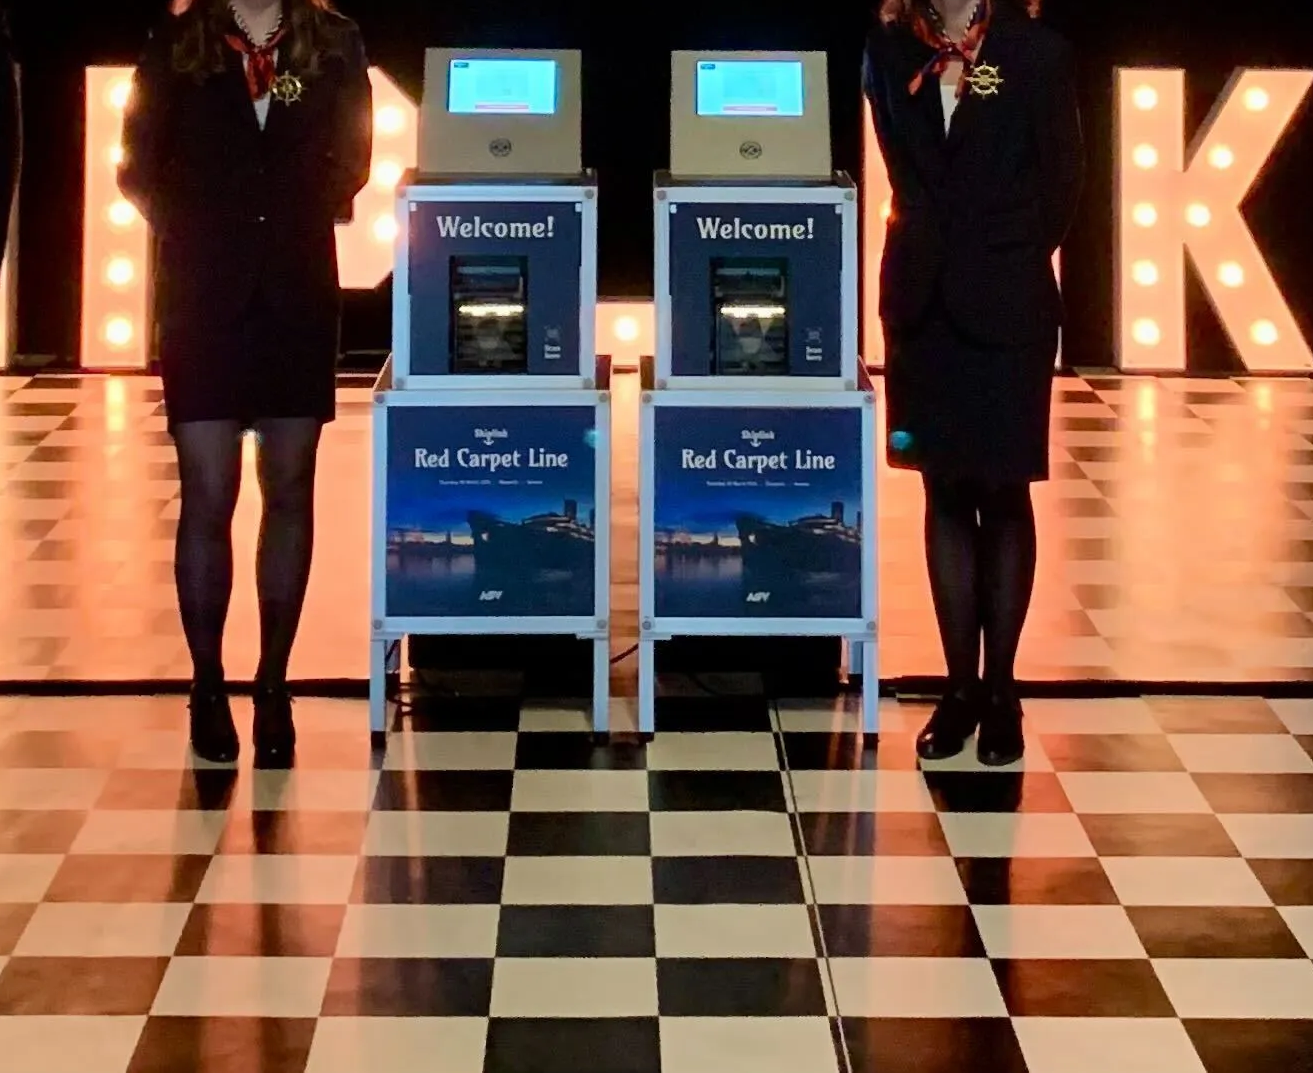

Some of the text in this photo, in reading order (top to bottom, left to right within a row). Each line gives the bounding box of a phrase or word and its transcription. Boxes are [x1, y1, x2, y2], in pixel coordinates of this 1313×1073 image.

[435, 215, 554, 238] Welcome!
[696, 217, 814, 240] Welcome!
[415, 447, 568, 473] Red Carpet Line
[682, 448, 835, 474] Red Carpet Line
